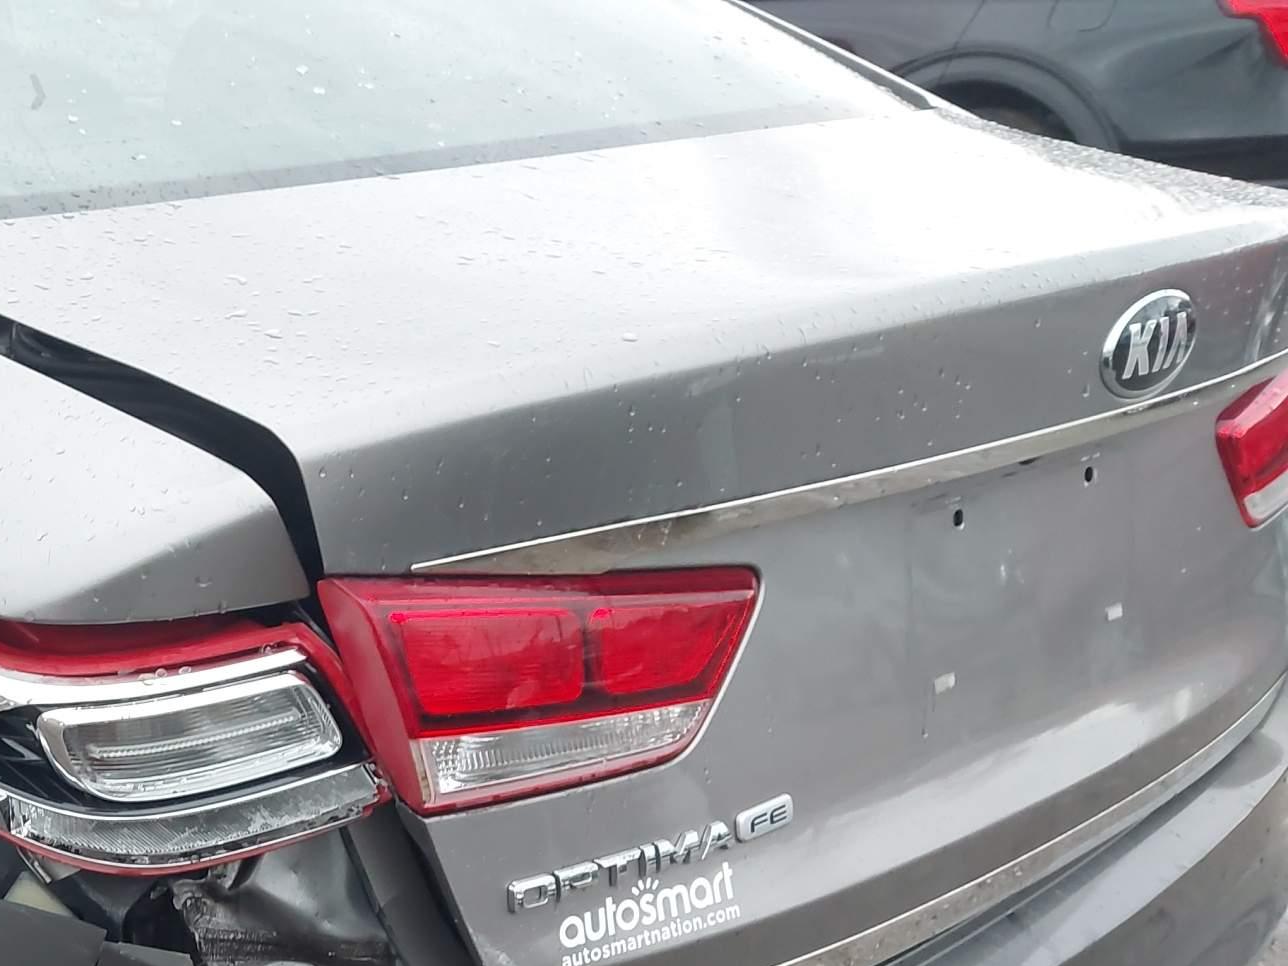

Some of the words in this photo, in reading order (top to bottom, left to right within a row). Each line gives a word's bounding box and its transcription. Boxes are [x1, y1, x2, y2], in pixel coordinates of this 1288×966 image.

[1121, 310, 1188, 380] KIA
[506, 820, 732, 913] OPTIMA
[750, 803, 787, 834] FE
[559, 861, 734, 948] autosmart
